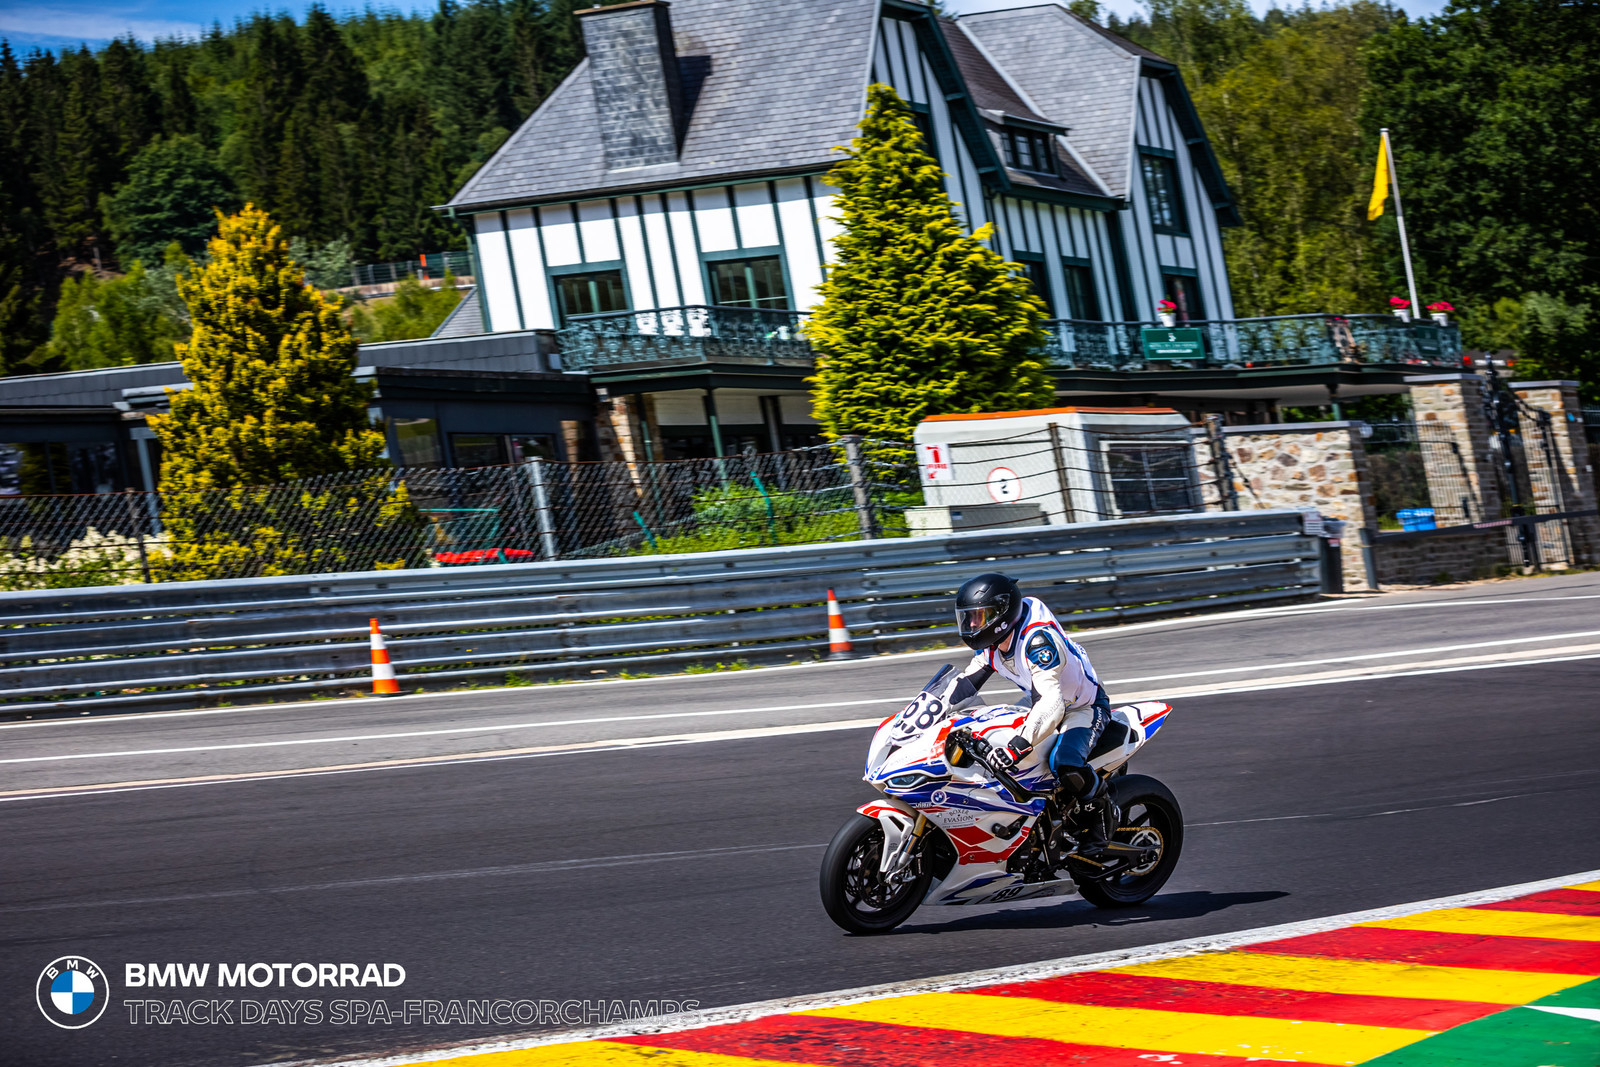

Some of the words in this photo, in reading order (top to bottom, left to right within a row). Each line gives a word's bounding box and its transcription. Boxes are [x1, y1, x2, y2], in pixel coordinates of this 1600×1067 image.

[903, 692, 943, 730] 68
[948, 809, 971, 817] BOXER
[944, 815, 974, 824] EVASION
[990, 886, 1025, 902] 89
